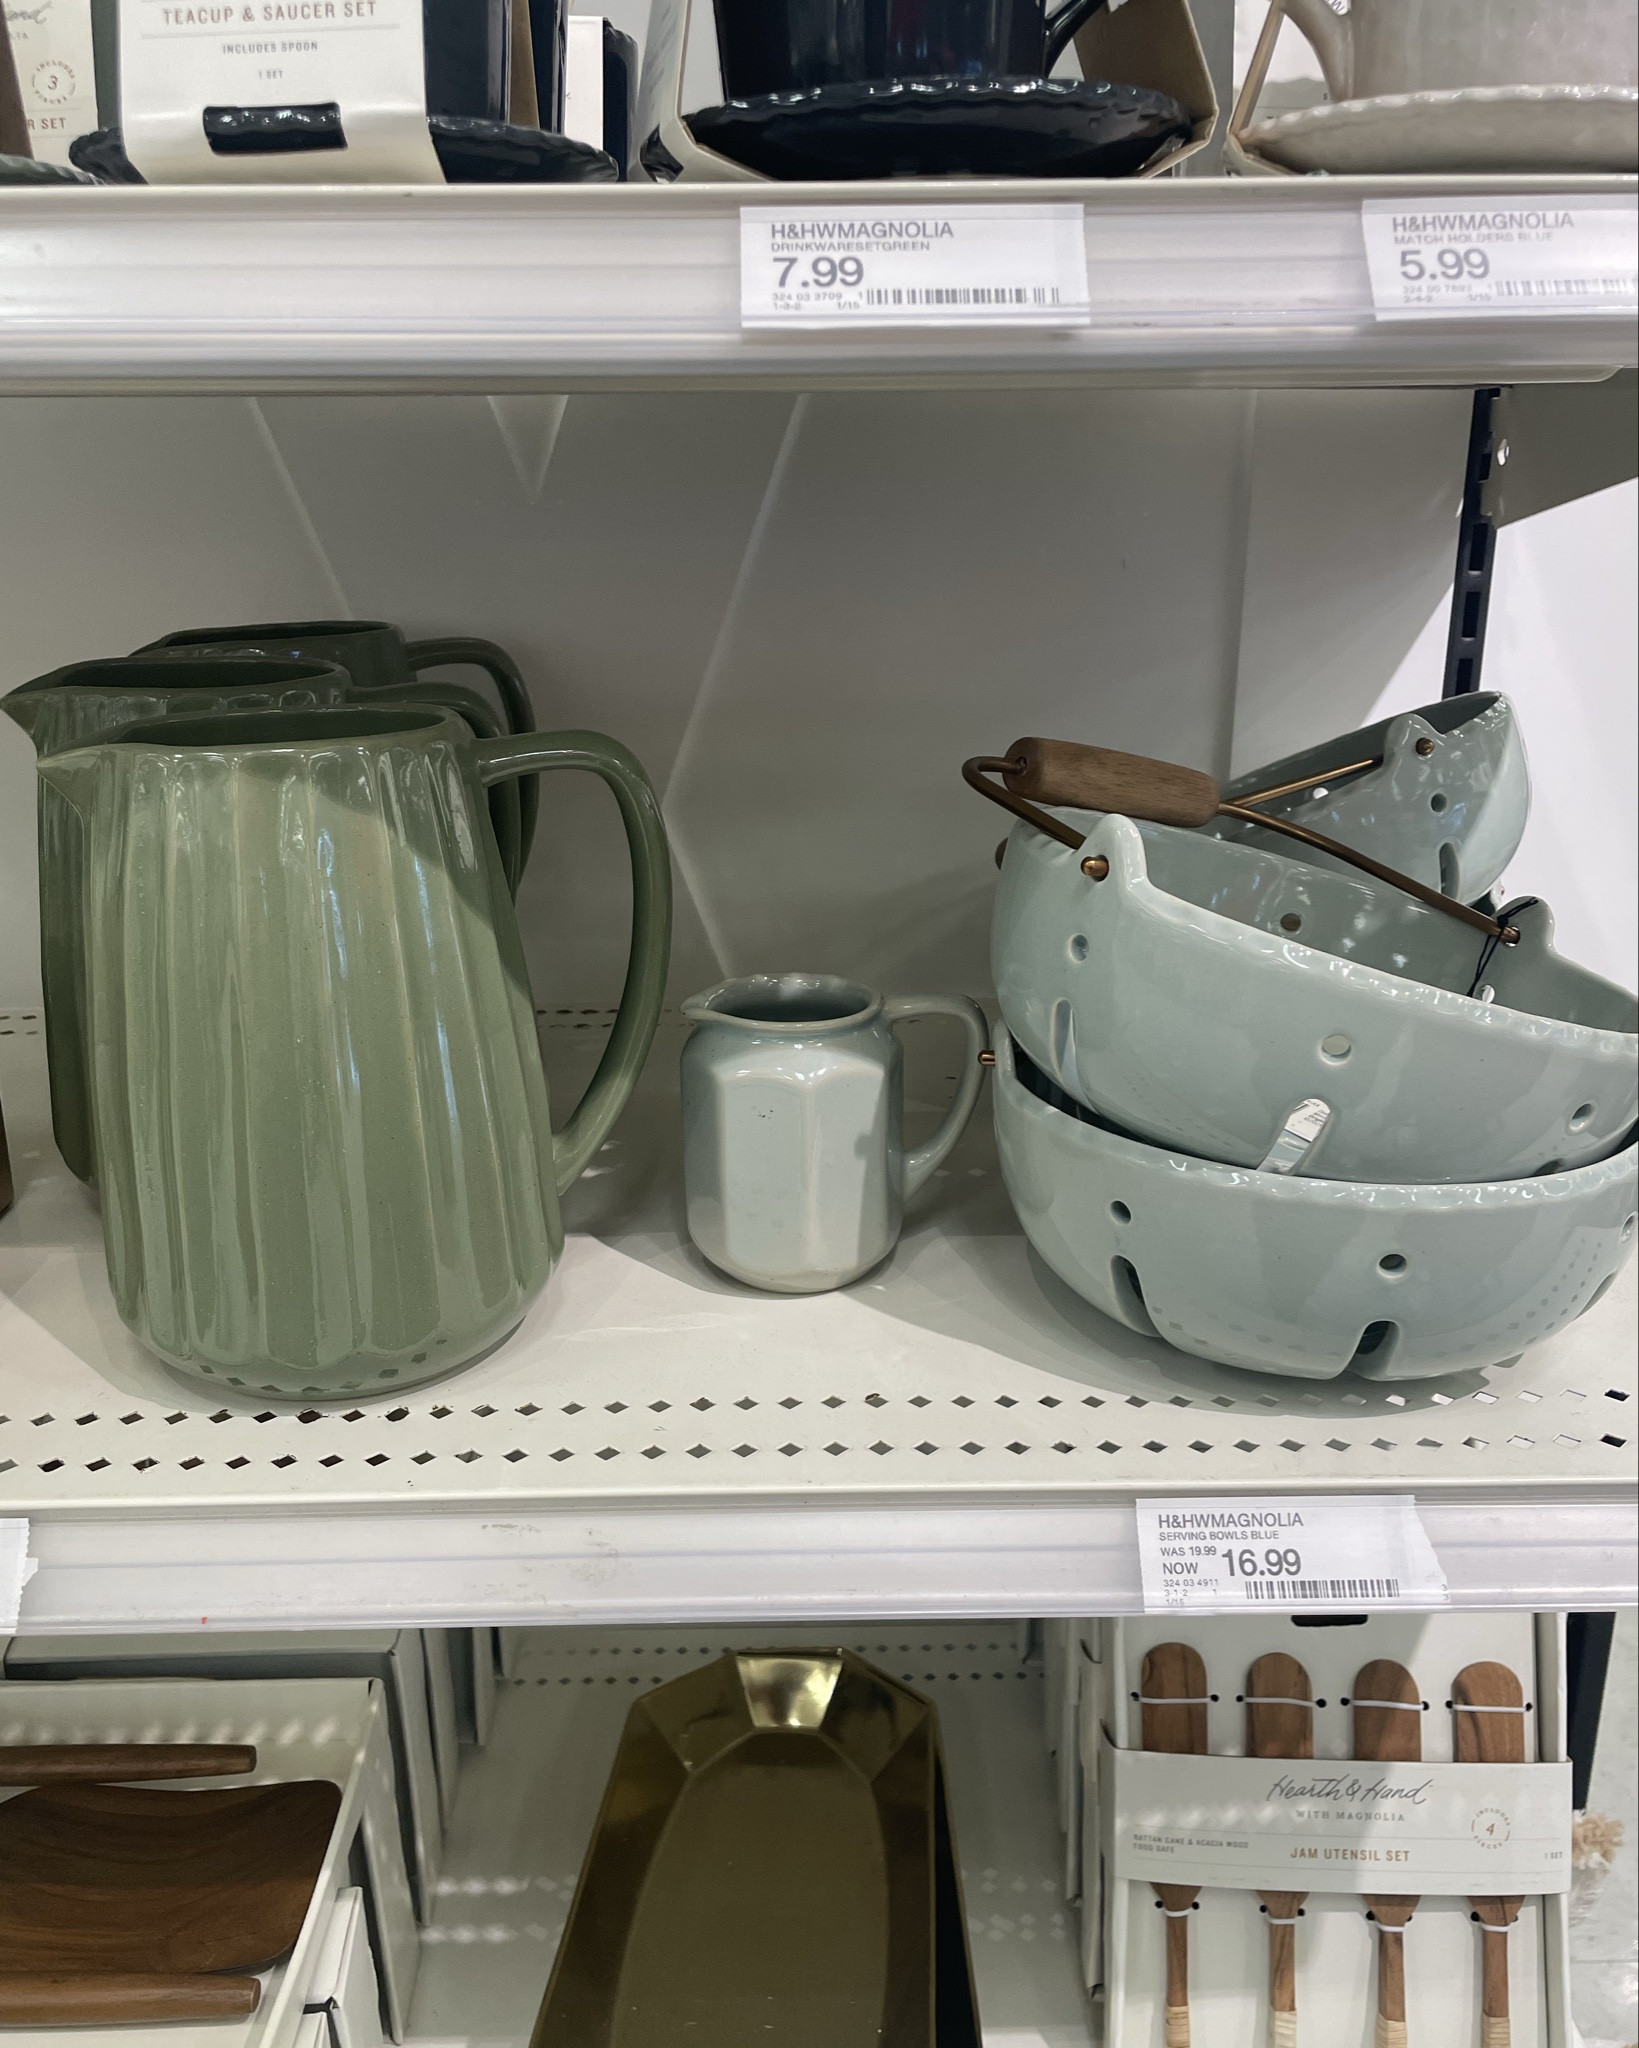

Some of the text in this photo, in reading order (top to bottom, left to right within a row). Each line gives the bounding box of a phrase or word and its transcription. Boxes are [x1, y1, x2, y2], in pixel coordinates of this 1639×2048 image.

[163, 0, 377, 25] TEACUP & SAUCER SET
[222, 41, 318, 54] INCLUDES SPOON
[266, 70, 284, 80] SET
[47, 75, 59, 90] 3
[41, 117, 66, 130] SET
[1392, 212, 1575, 233] H&HWMAGNOLIA
[771, 221, 955, 239] H&HWMAGNOLIA
[1394, 231, 1553, 245] MATCH HOLDERS BLUE
[771, 241, 930, 252] DRINKWARESETGREEN
[772, 256, 864, 287] 7.99
[1400, 248, 1490, 281] 5.99
[1158, 1512, 1304, 1528] H&HWMAGNOLIA
[1159, 1530, 1280, 1541] SERVING BOWLS BLUE
[1160, 1545, 1217, 1556] WAS 19.99
[1162, 1548, 1302, 1576] NOW 16.99
[1163, 1578, 1219, 1587] 324 03 4911
[1266, 1773, 1433, 1805] Hearth & Hand
[1296, 1810, 1405, 1821] WITH MAGNOLIA
[1486, 1823, 1495, 1836] 4
[1290, 1847, 1410, 1862] JAM UTENSIL SET
[1550, 1851, 1563, 1859] SET
